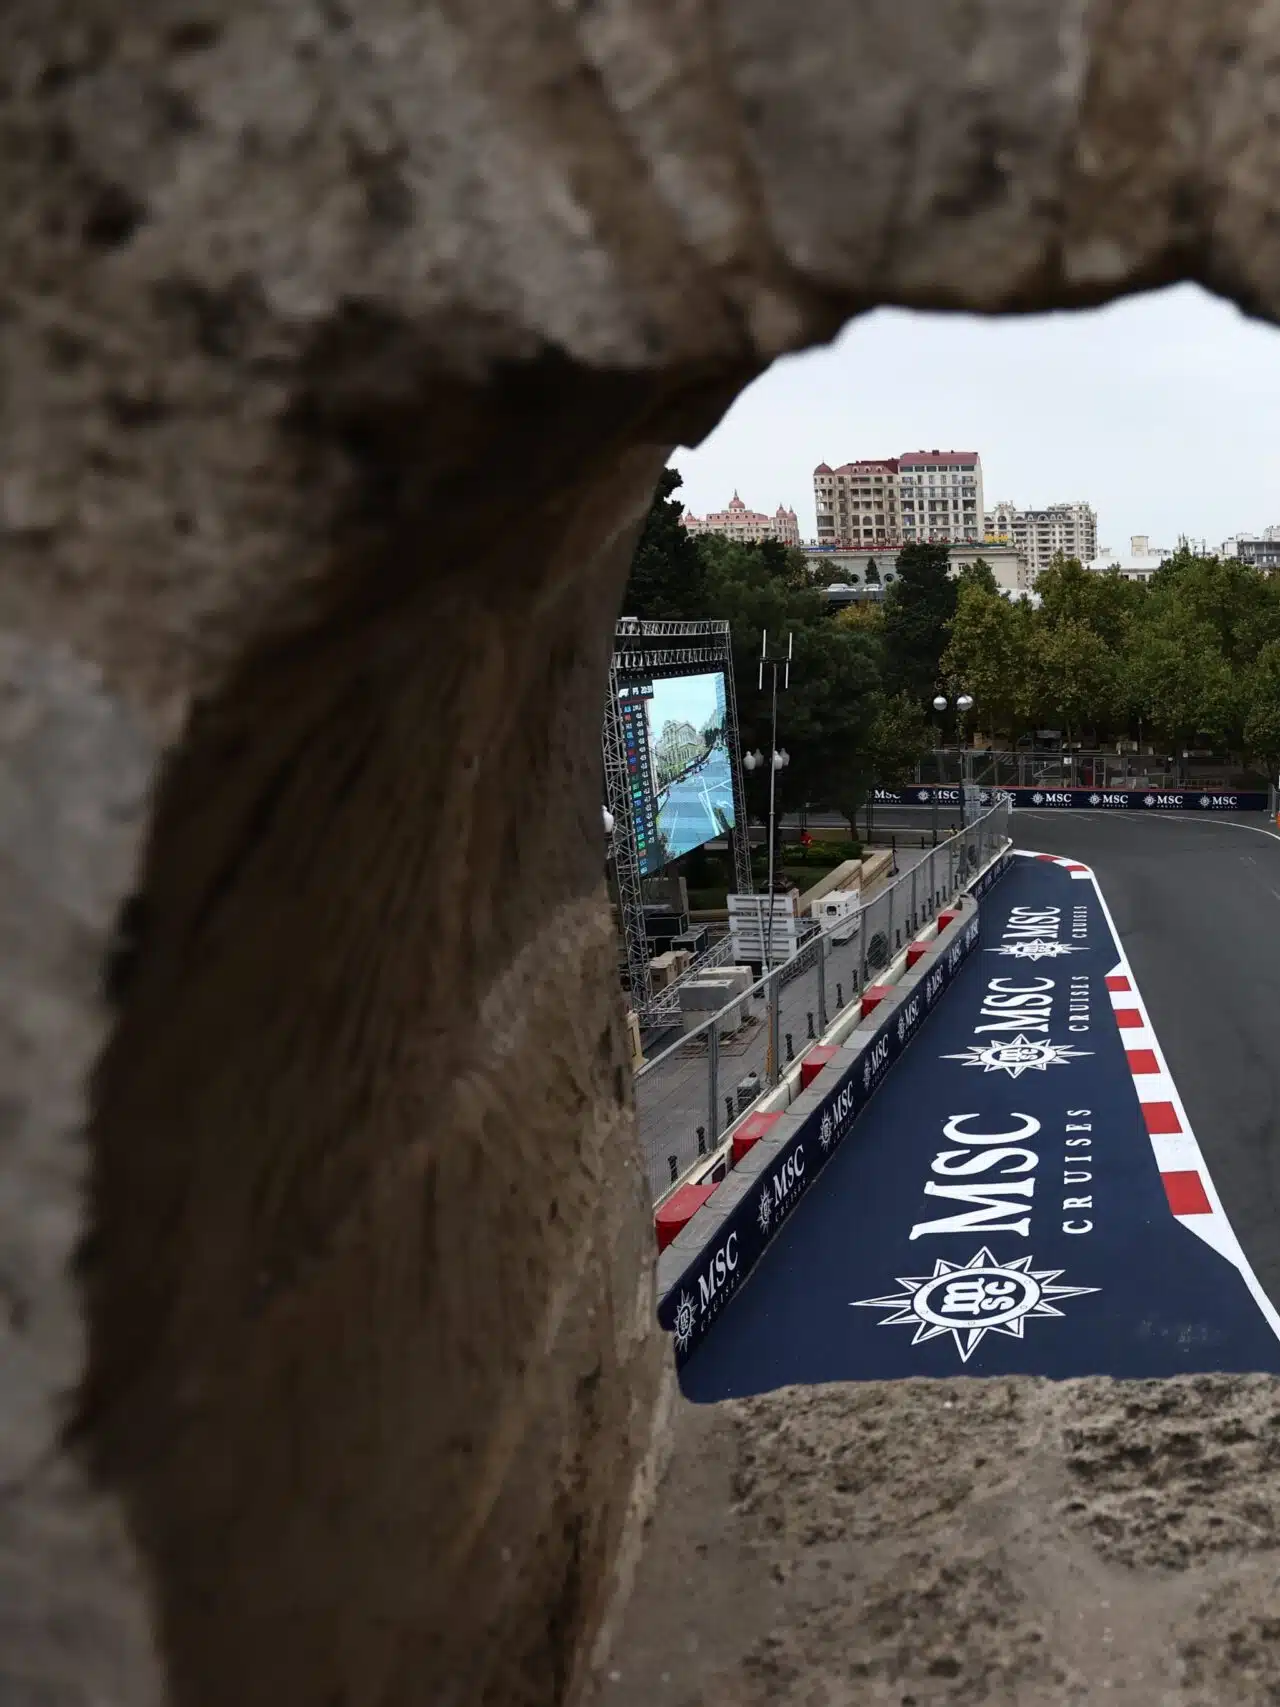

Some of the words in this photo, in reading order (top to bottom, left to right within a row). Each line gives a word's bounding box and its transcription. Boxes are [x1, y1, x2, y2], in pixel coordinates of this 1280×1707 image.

[1045, 793, 1072, 803] MSC
[1102, 794, 1129, 804] MSC
[1157, 795, 1183, 805] MSC
[1212, 796, 1238, 806] MSC
[1002, 906, 1061, 939] MSC
[1071, 905, 1088, 939] CRUISES
[973, 976, 1056, 1034] MSC
[1068, 975, 1090, 1032] CRUISES
[872, 1034, 888, 1075] MSC
[832, 1080, 854, 1130] MSC
[773, 1144, 805, 1207] MSC
[908, 1112, 1041, 1241] MSC
[1062, 1109, 1093, 1235] CRUISES
[698, 1231, 739, 1314] MSC
[701, 1269, 741, 1332] CRUISES
